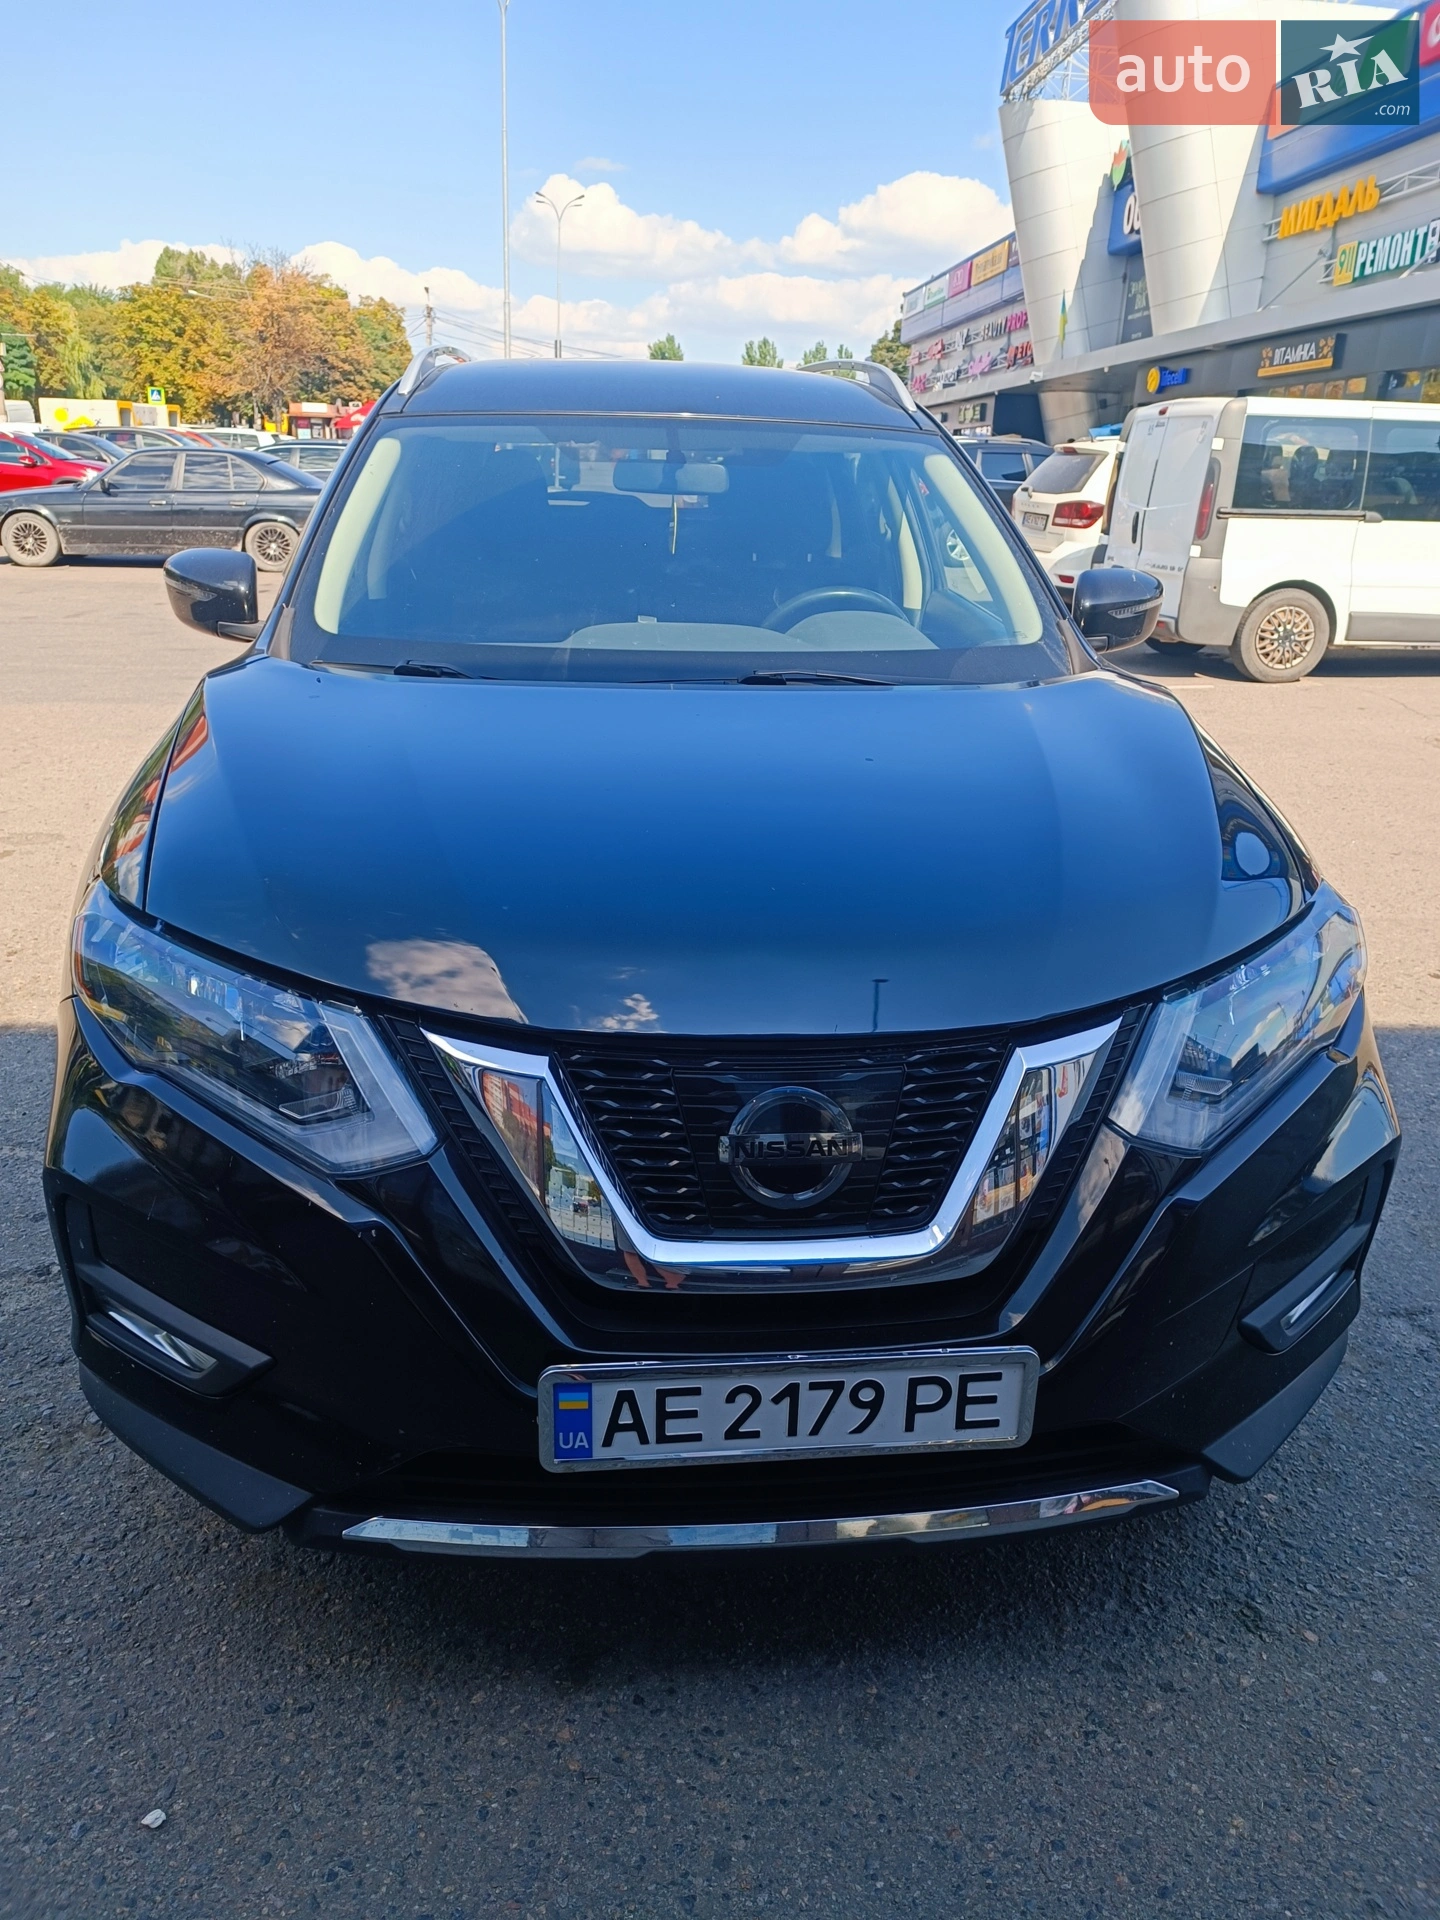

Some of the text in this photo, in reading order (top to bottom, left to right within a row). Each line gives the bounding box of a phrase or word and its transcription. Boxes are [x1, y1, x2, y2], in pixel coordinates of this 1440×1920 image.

[1277, 174, 1381, 240] МИГДАЛЬ
[1354, 224, 1429, 278] РЕМОНТ
[734, 1138, 848, 1159] NISSAN
[601, 1371, 1003, 1448] AE 2179 PE
[558, 1431, 589, 1450] UA
